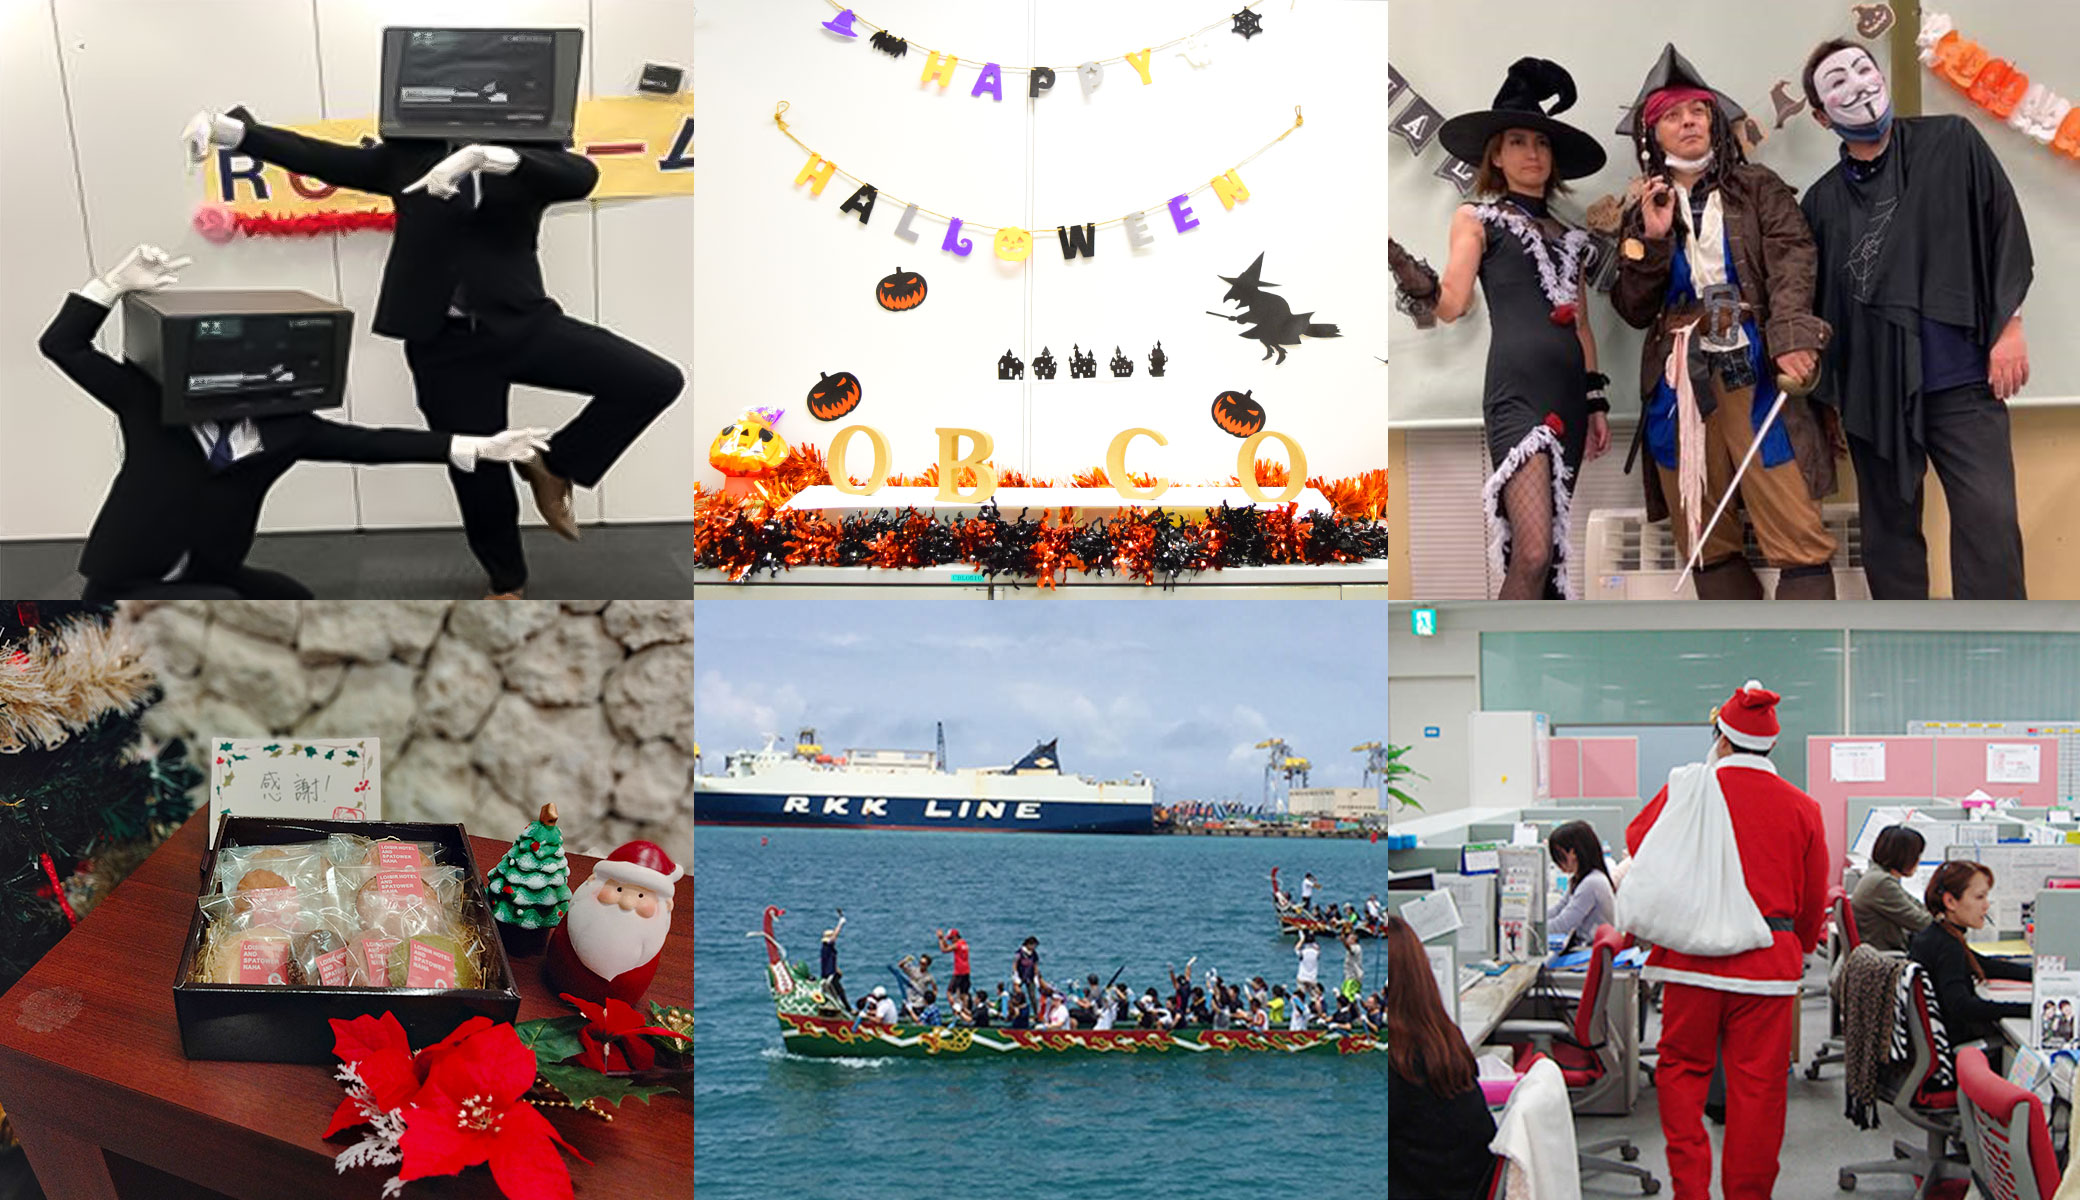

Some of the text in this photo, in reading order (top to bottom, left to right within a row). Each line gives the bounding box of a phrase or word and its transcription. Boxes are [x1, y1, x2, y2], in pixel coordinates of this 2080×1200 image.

[920, 48, 1152, 101] HAPPY
[794, 152, 1251, 262] HALLOWEEN
[260, 771, 332, 804] 感謝!
[783, 796, 1042, 819] RKK LINE
[413, 943, 452, 962] LOISIR HOTEL
[413, 950, 426, 958] AND
[322, 964, 334, 972] AND
[413, 955, 446, 971] SPATOWER
[413, 961, 430, 972] NAHA
